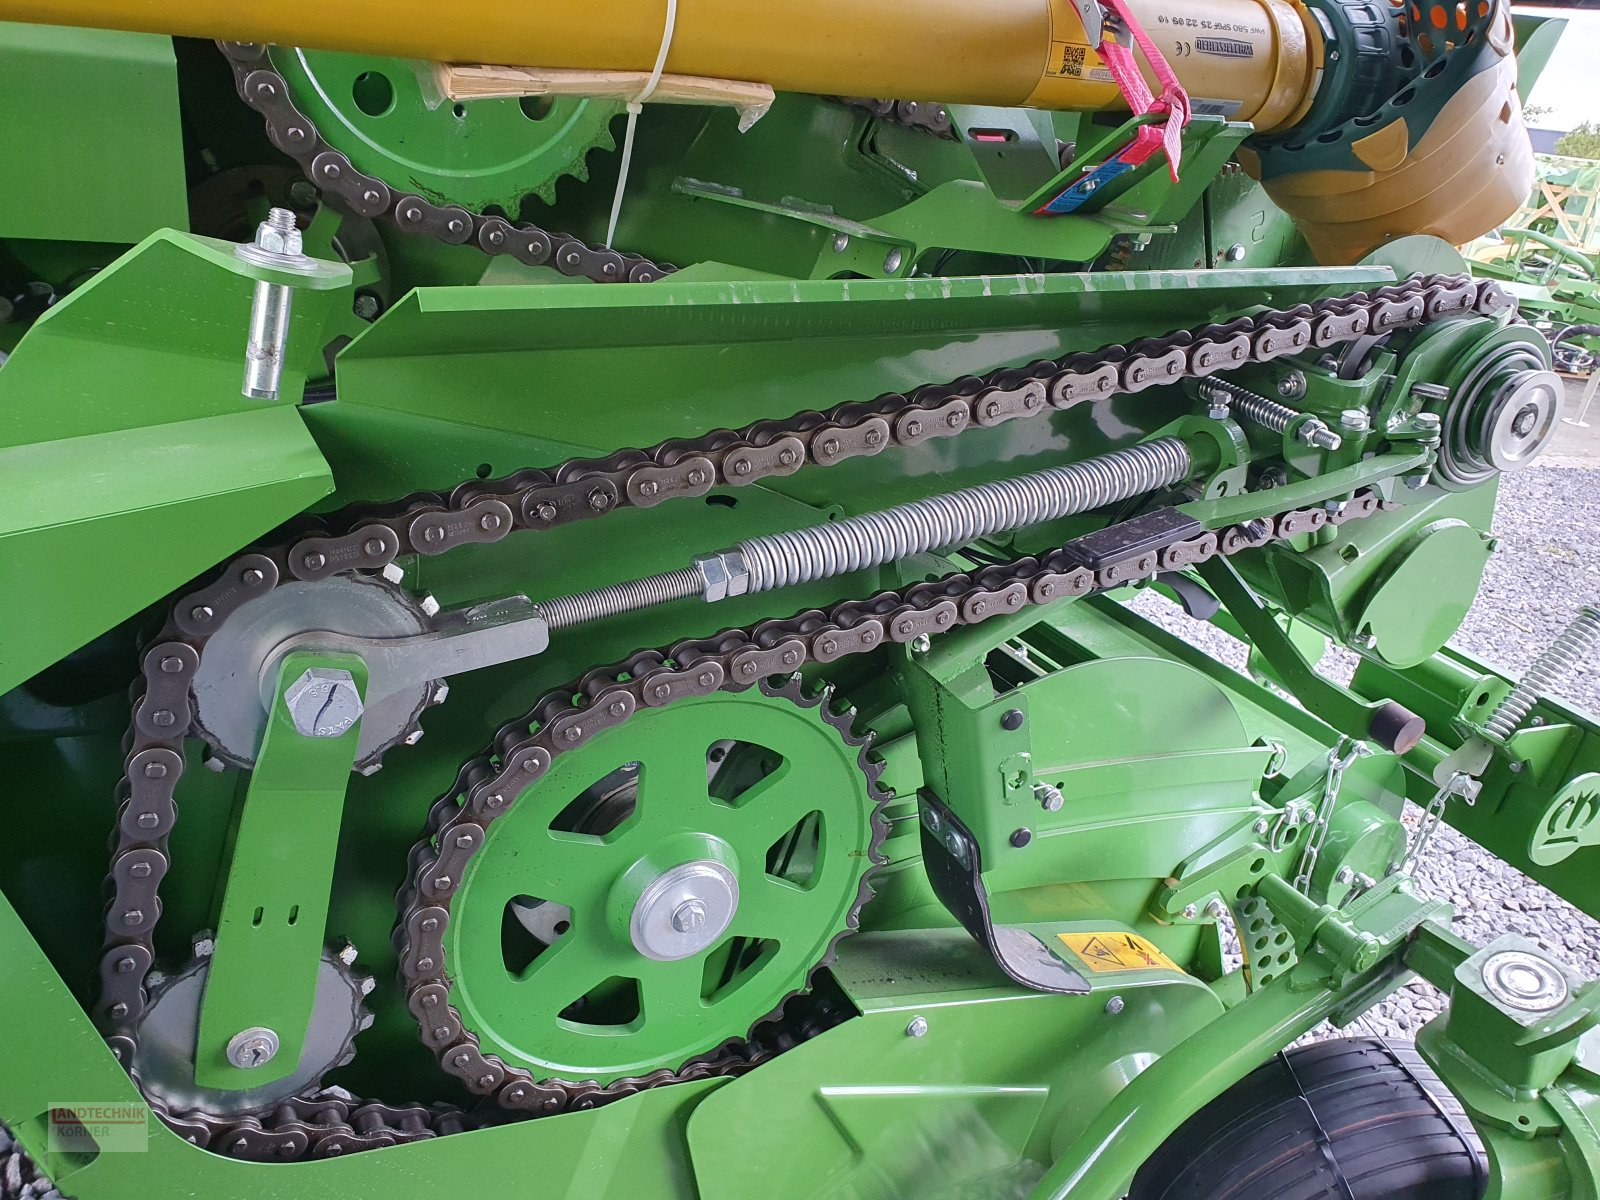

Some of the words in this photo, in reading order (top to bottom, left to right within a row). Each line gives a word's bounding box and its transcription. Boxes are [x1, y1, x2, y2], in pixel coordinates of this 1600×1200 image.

[1185, 18, 1199, 27] 22
[1200, 20, 1213, 29] 25
[1233, 24, 1249, 33] 580
[1195, 37, 1254, 57] WALTERSCHEID
